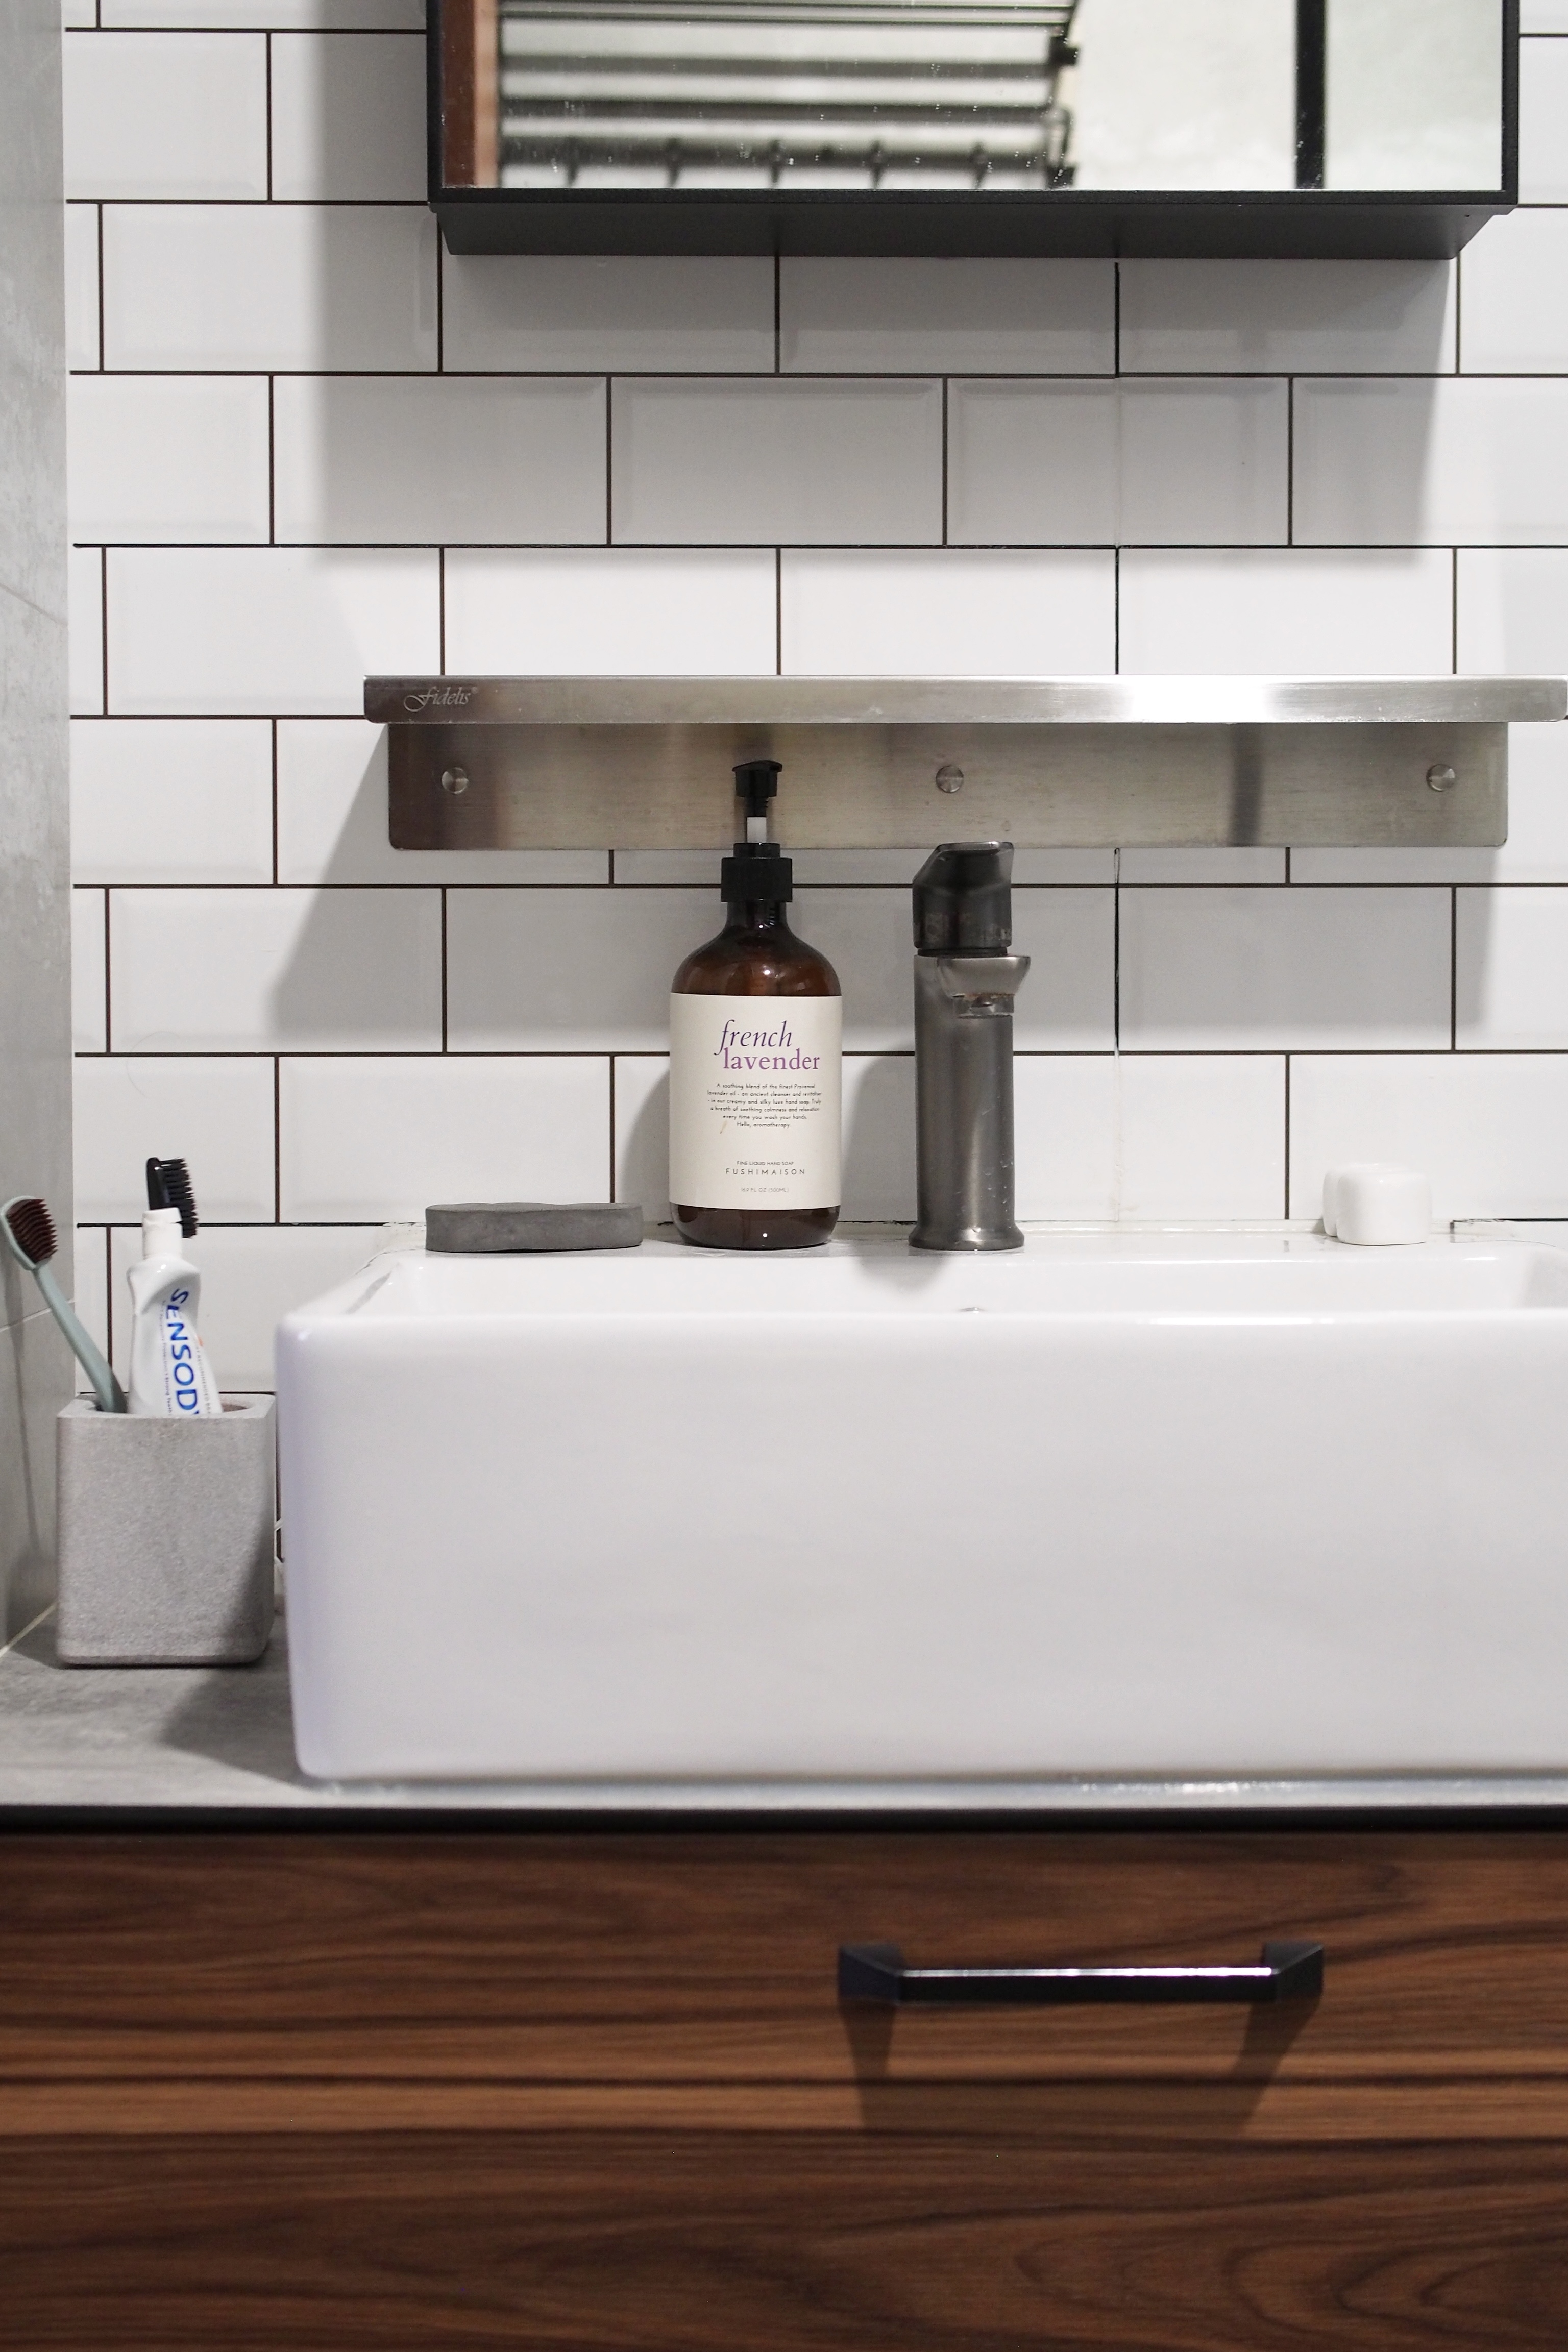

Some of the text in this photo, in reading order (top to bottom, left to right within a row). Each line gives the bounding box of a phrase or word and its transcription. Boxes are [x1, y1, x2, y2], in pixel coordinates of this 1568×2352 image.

[714, 1019, 792, 1056] french
[723, 1047, 820, 1070] lavender
[166, 1288, 200, 1414] SENSOD
